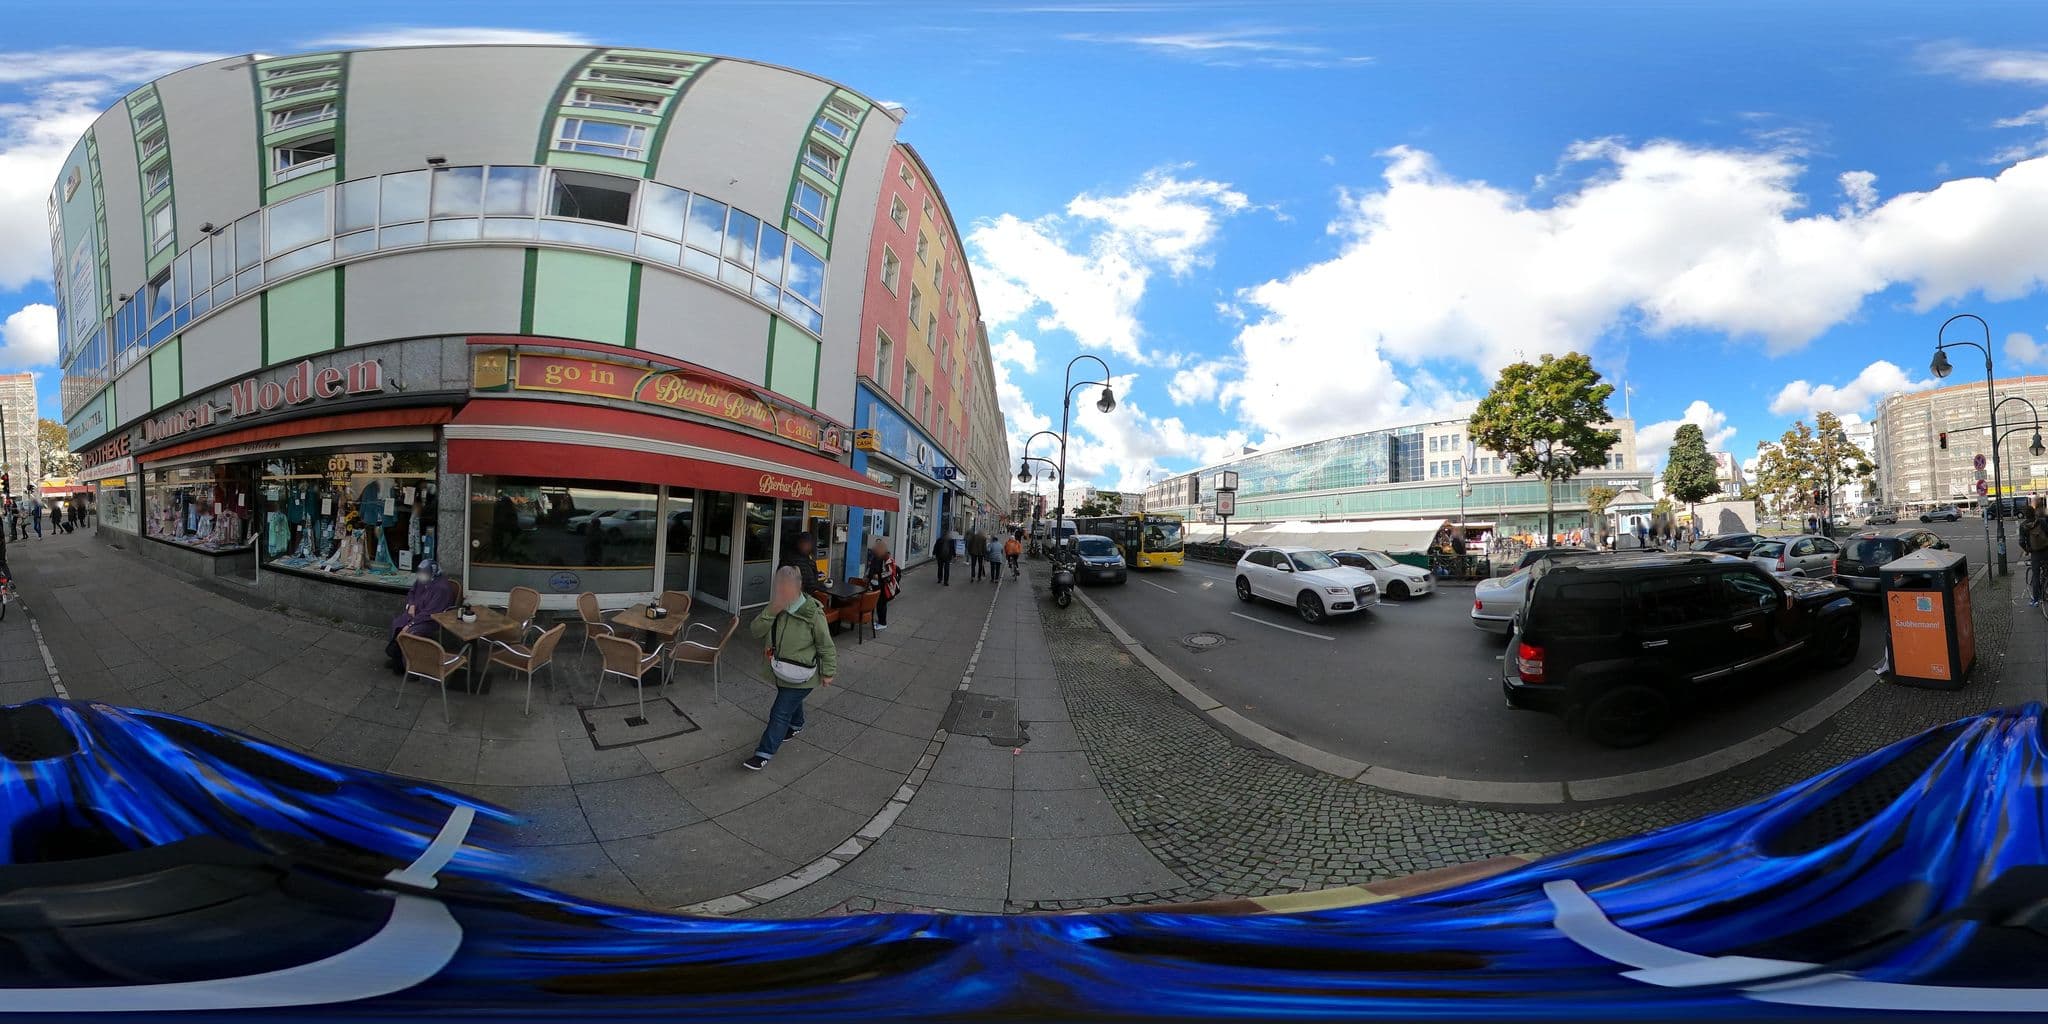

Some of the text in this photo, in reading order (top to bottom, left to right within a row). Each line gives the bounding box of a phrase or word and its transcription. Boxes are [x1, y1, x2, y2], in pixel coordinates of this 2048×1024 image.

[545, 362, 615, 385] go in
[145, 359, 381, 443] Damen-Moden
[655, 374, 768, 422] Bierbar Berlin
[785, 418, 812, 440] Cafe
[84, 433, 129, 469] APOTHEKE
[328, 459, 347, 471] 60
[759, 474, 813, 497] Bierbar Berlin
